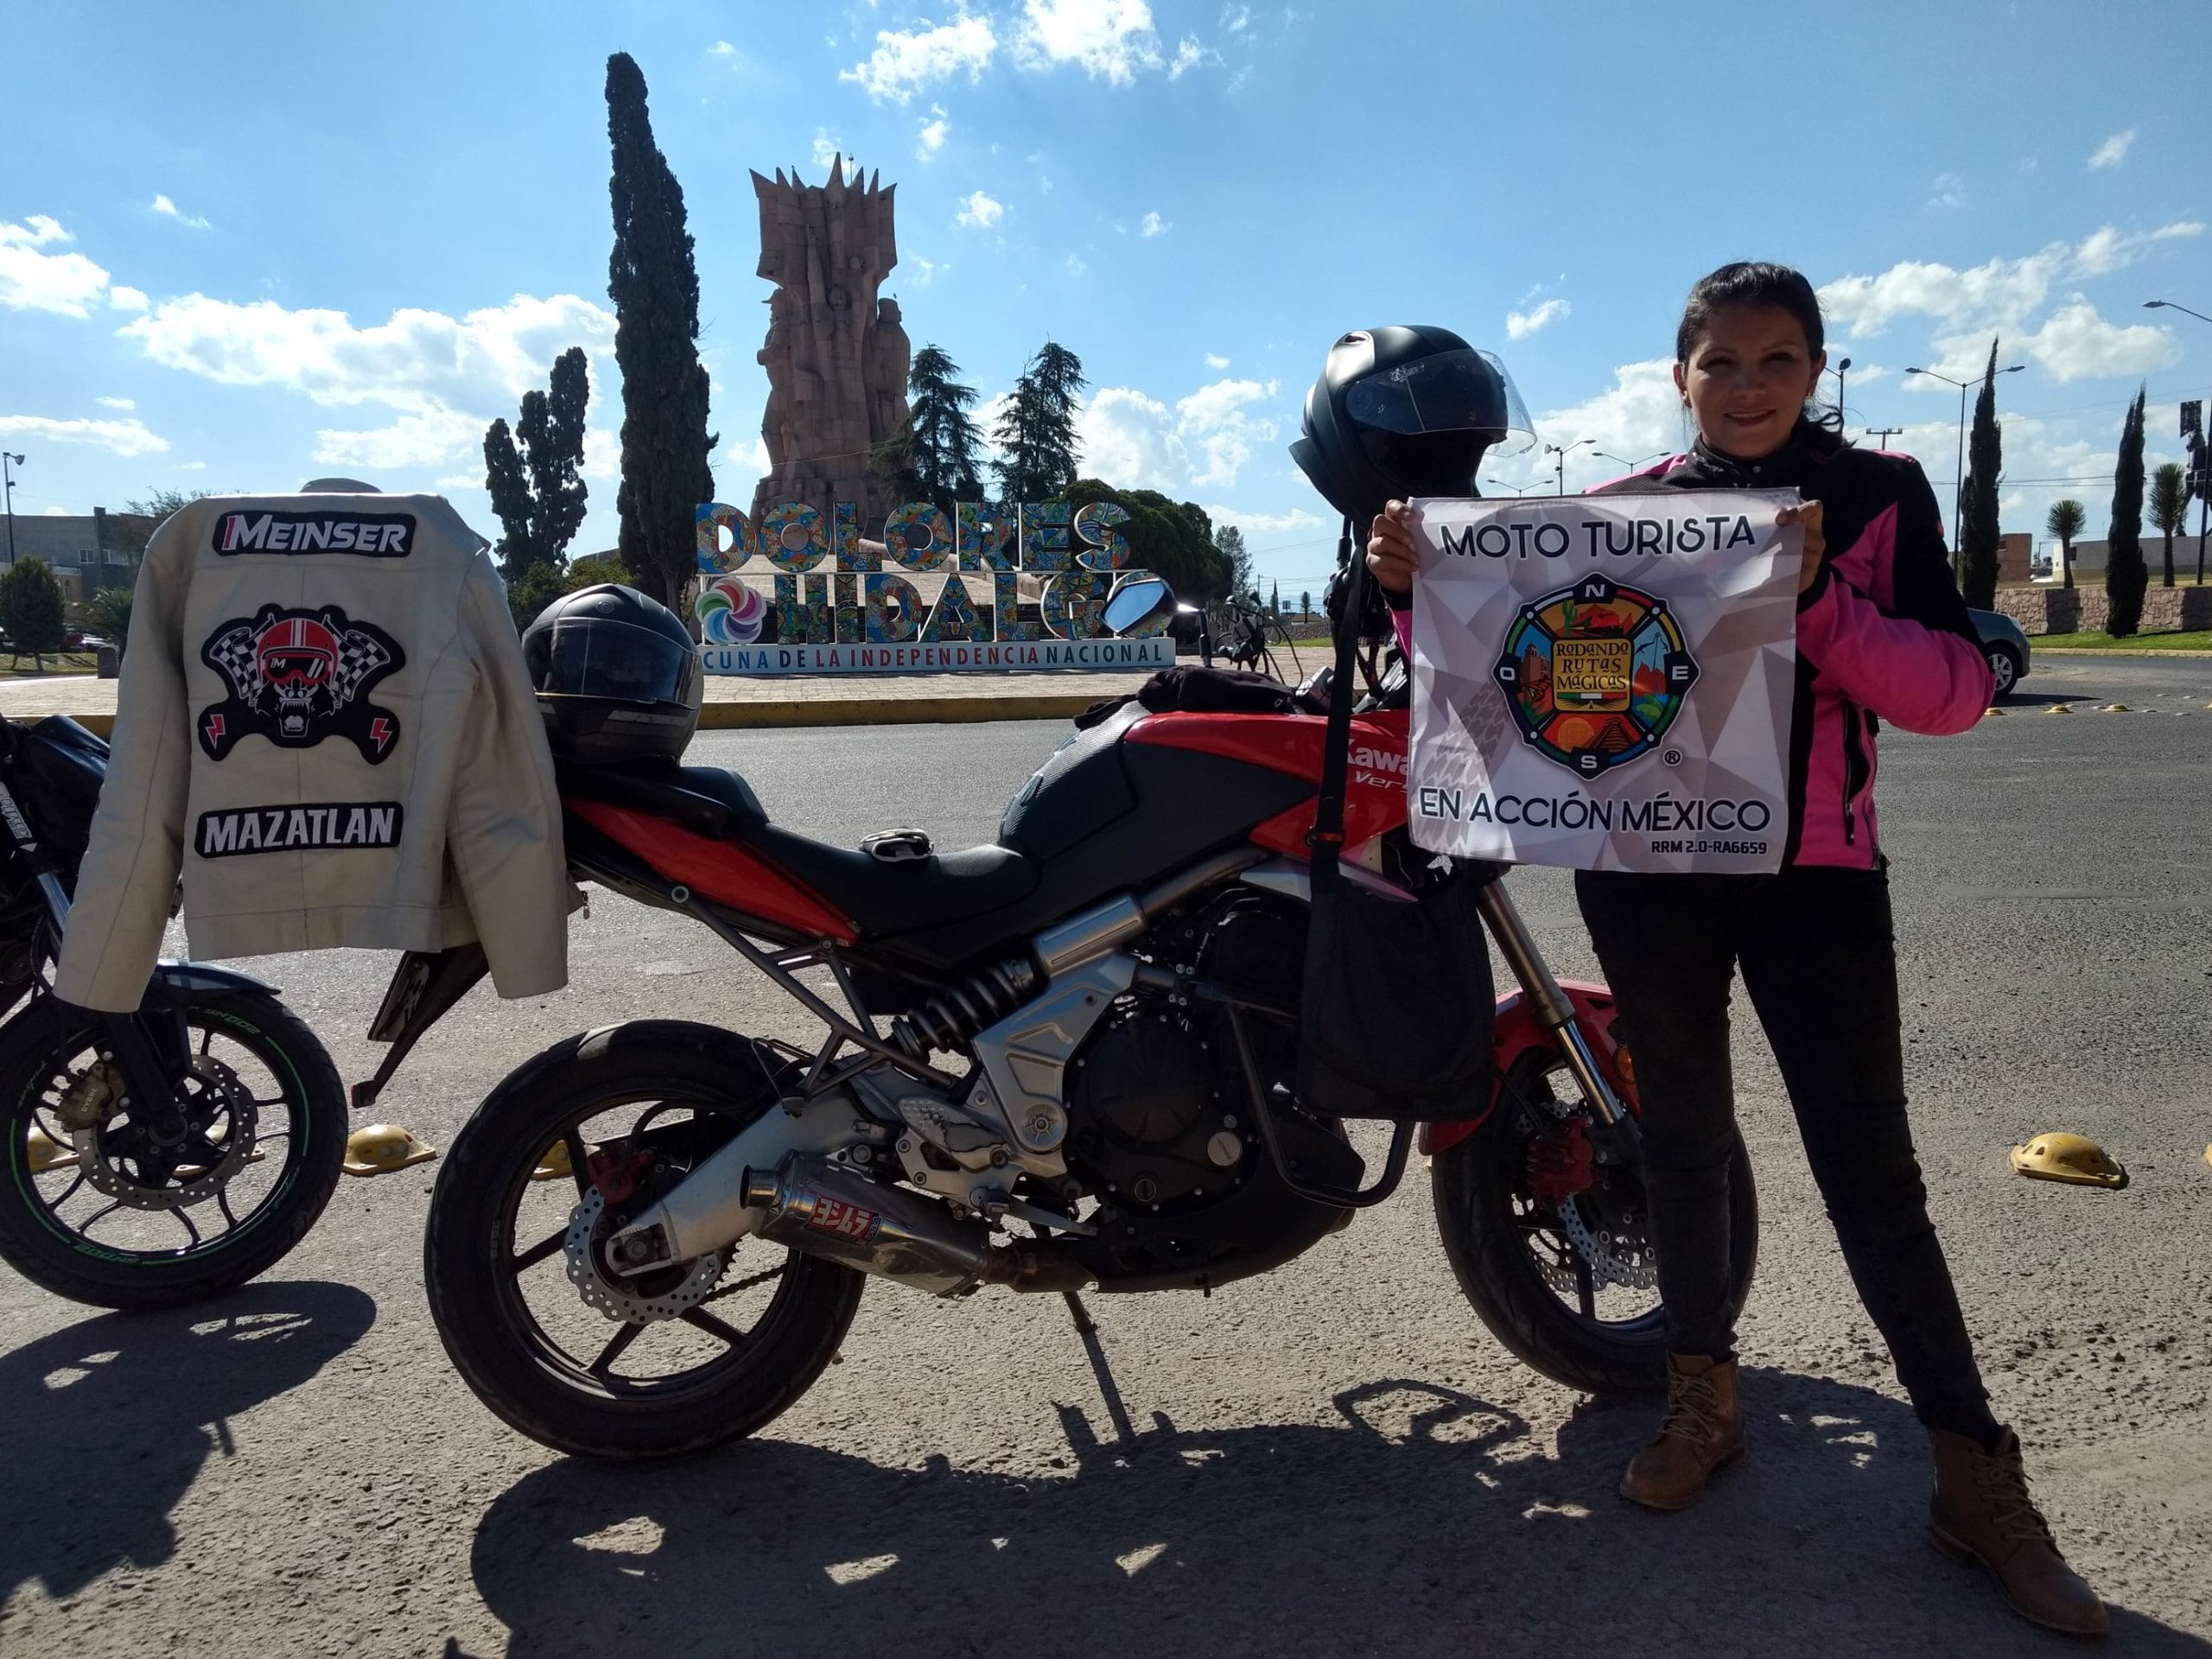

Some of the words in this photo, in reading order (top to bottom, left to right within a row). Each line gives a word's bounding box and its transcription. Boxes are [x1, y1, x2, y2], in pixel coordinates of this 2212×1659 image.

[696, 501, 1130, 573] DOLORES
[1440, 523, 1569, 558] MOTO
[1582, 515, 1755, 557] TURISTA
[1585, 584, 1605, 597] N
[702, 650, 768, 669] CUNA
[779, 650, 805, 668] DE
[816, 649, 840, 667] LA
[850, 647, 1038, 666] INDEPENDENCIA
[1046, 645, 1162, 664] NACIONAL
[1672, 666, 1690, 680] E
[1580, 755, 1598, 769] S
[1420, 788, 1461, 820] EN
[1469, 790, 1612, 830] ACCIÓN
[1621, 791, 1770, 831] MÉXICO
[204, 809, 395, 854] MAZATLAN
[1651, 841, 1682, 854] RRM
[1686, 841, 1767, 855] 2.0-RA6659
[813, 1198, 870, 1236] ヨシムラ
